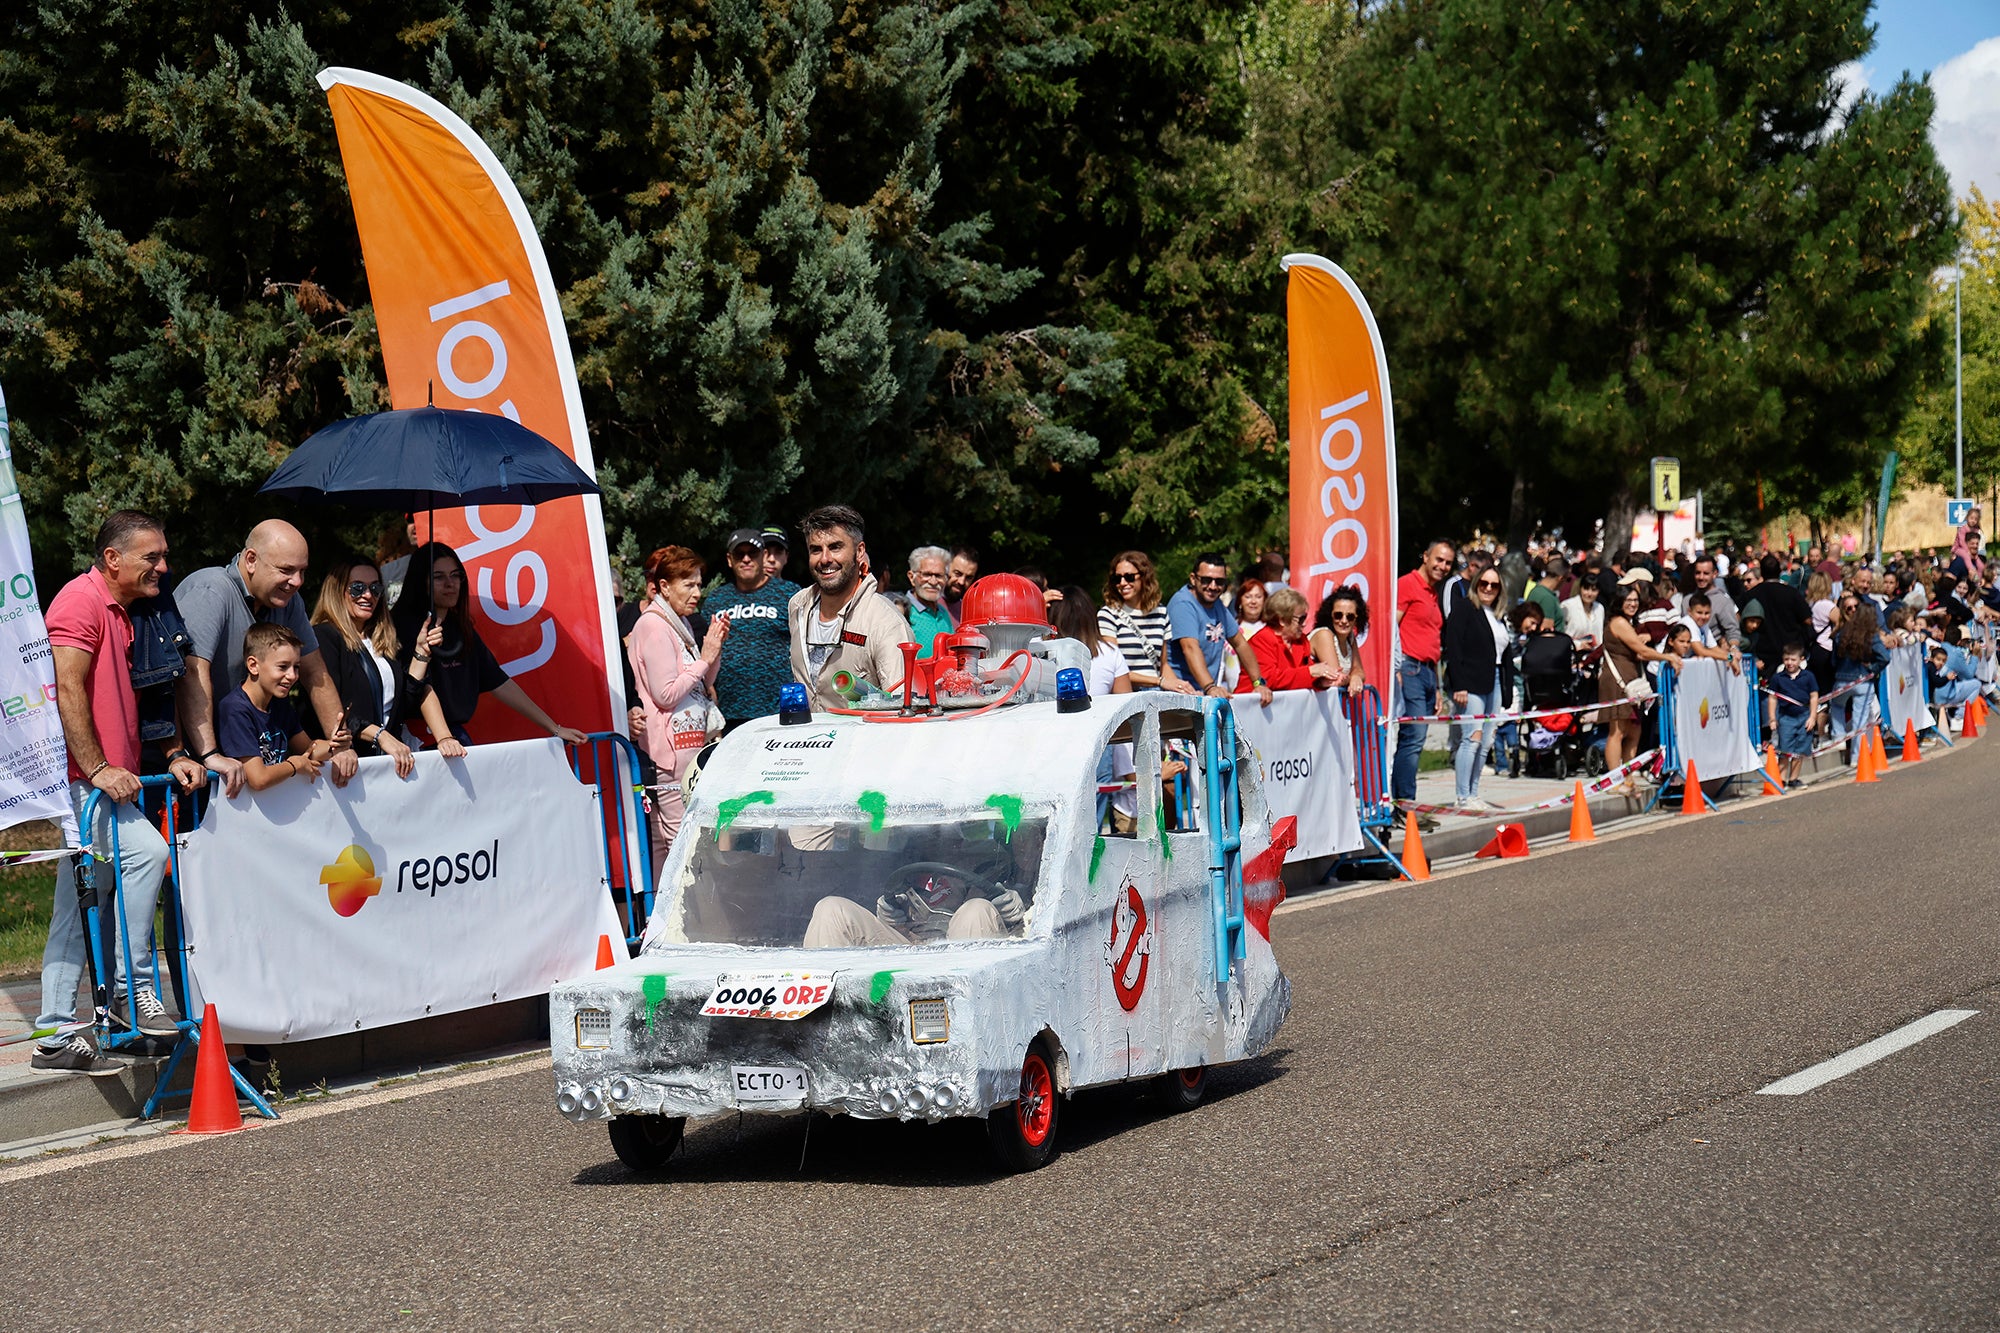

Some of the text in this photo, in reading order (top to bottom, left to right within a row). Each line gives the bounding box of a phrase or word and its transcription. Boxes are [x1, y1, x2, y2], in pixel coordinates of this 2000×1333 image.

[716, 603, 778, 621] adidas
[765, 739, 834, 751] La casuca
[1270, 752, 1312, 786] repsol
[397, 839, 499, 897] repsol
[716, 985, 828, 1005] 0006 ORE
